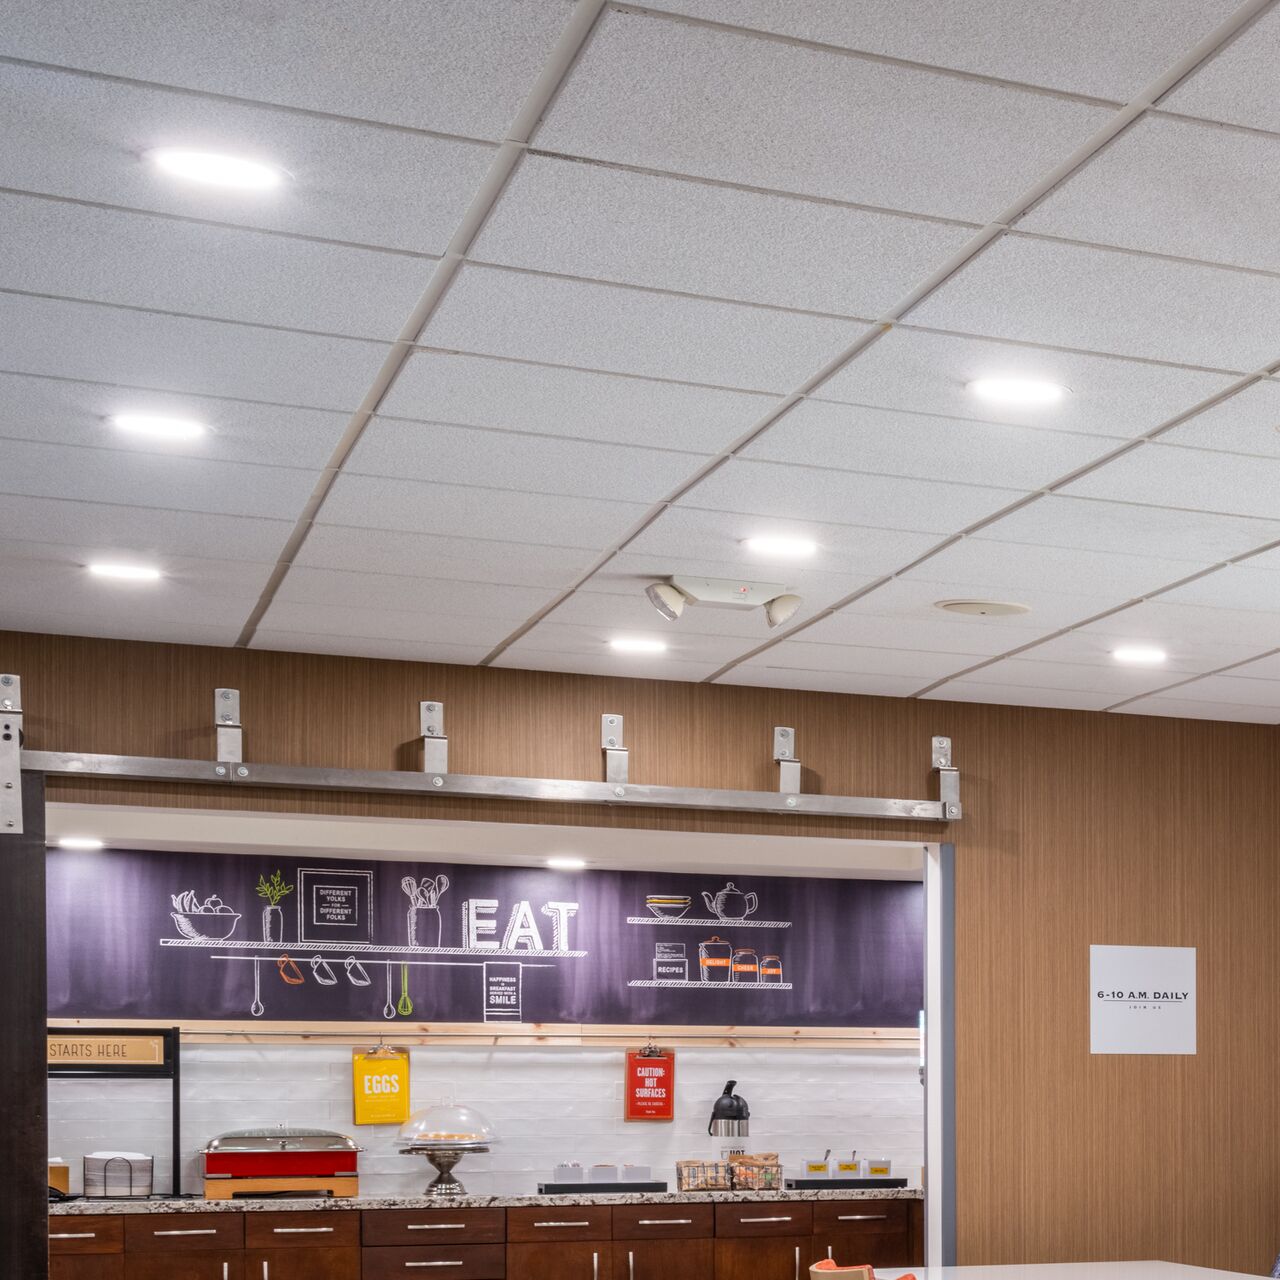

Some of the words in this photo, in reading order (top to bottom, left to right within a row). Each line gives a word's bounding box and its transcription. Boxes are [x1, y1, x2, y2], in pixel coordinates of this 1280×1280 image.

[462, 899, 579, 951] EAT
[489, 995, 517, 1004] SMILE
[49, 1043, 92, 1057] STARTS
[97, 1044, 127, 1057] HERE
[637, 1067, 665, 1076] CAUTION:
[364, 1074, 399, 1094] EGGS
[644, 1078, 657, 1087] HOT
[635, 1088, 666, 1098] SURFACES
